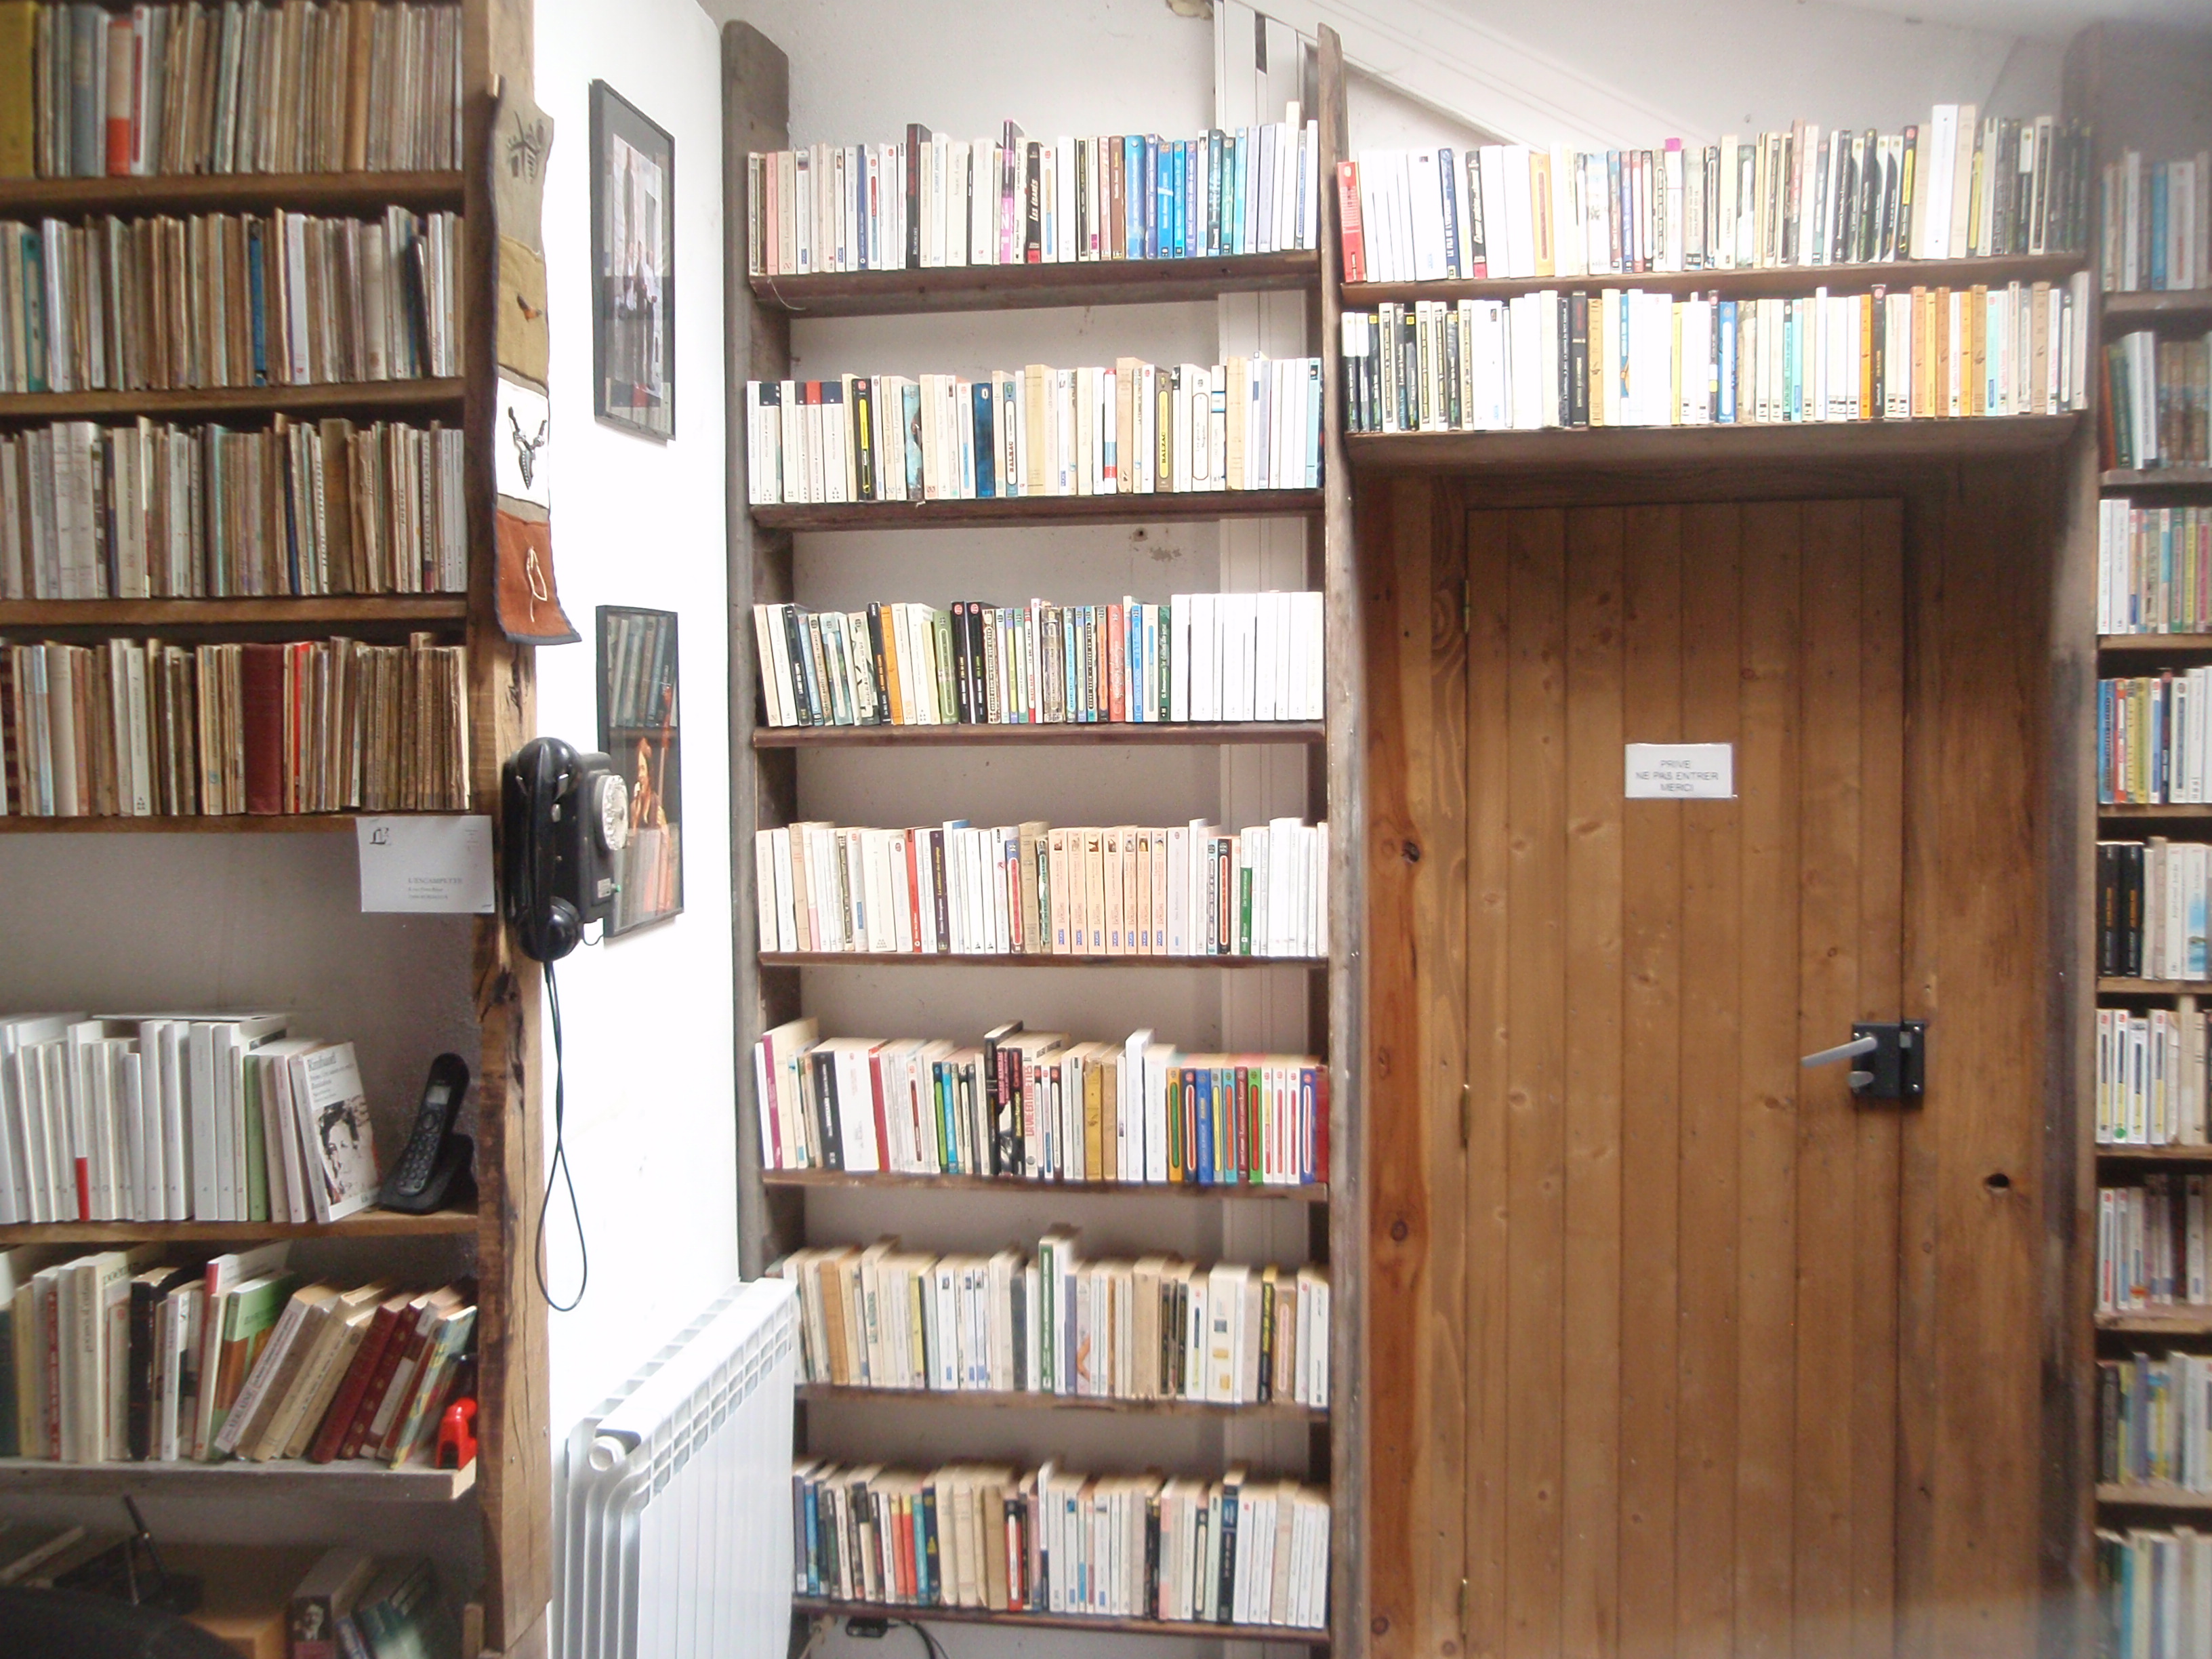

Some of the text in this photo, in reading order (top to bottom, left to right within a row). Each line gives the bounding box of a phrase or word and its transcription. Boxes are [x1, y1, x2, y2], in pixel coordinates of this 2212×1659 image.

[1635, 771, 1719, 780] NE PAS ENTRER
[1660, 783, 1694, 792] MERCI
[1023, 1065, 1035, 1136] LA VIE EN MIETTES
